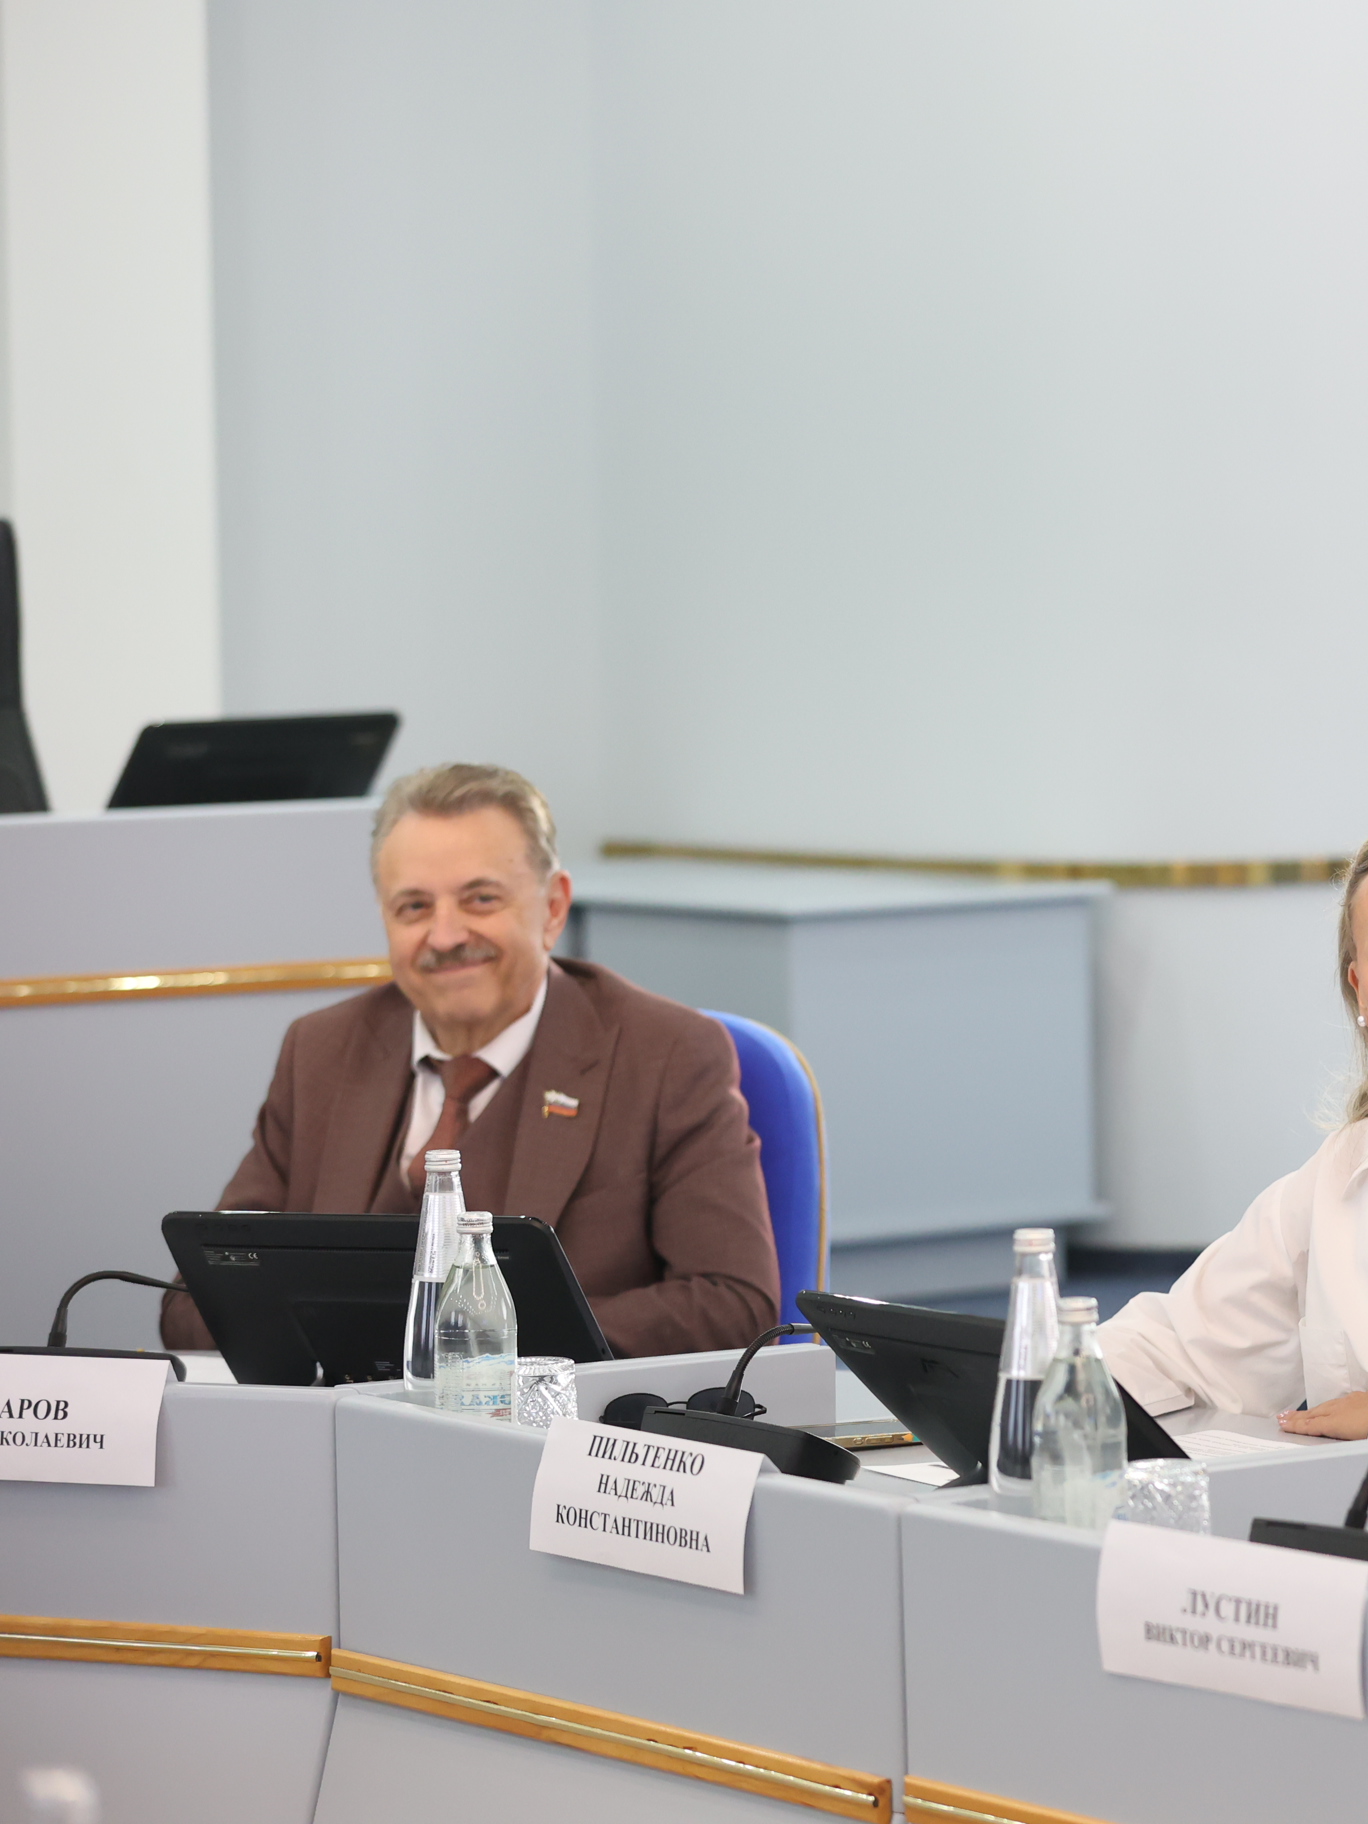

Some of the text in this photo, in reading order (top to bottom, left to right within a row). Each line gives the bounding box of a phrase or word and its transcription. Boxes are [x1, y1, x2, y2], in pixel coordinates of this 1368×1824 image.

[0, 1398, 69, 1421] АРОВ
[0, 1430, 105, 1450] КОЛАЕВИЧ
[587, 1434, 705, 1476] ПИЛЬТЕНКО
[597, 1473, 675, 1509] НАДЕЖДА
[555, 1503, 711, 1553] КОНСТАНТИНОВНА
[1181, 1588, 1280, 1631] ЛУСТИН
[1143, 1620, 1320, 1673] ВИКТОР СЕРГЕЕВИЧ
